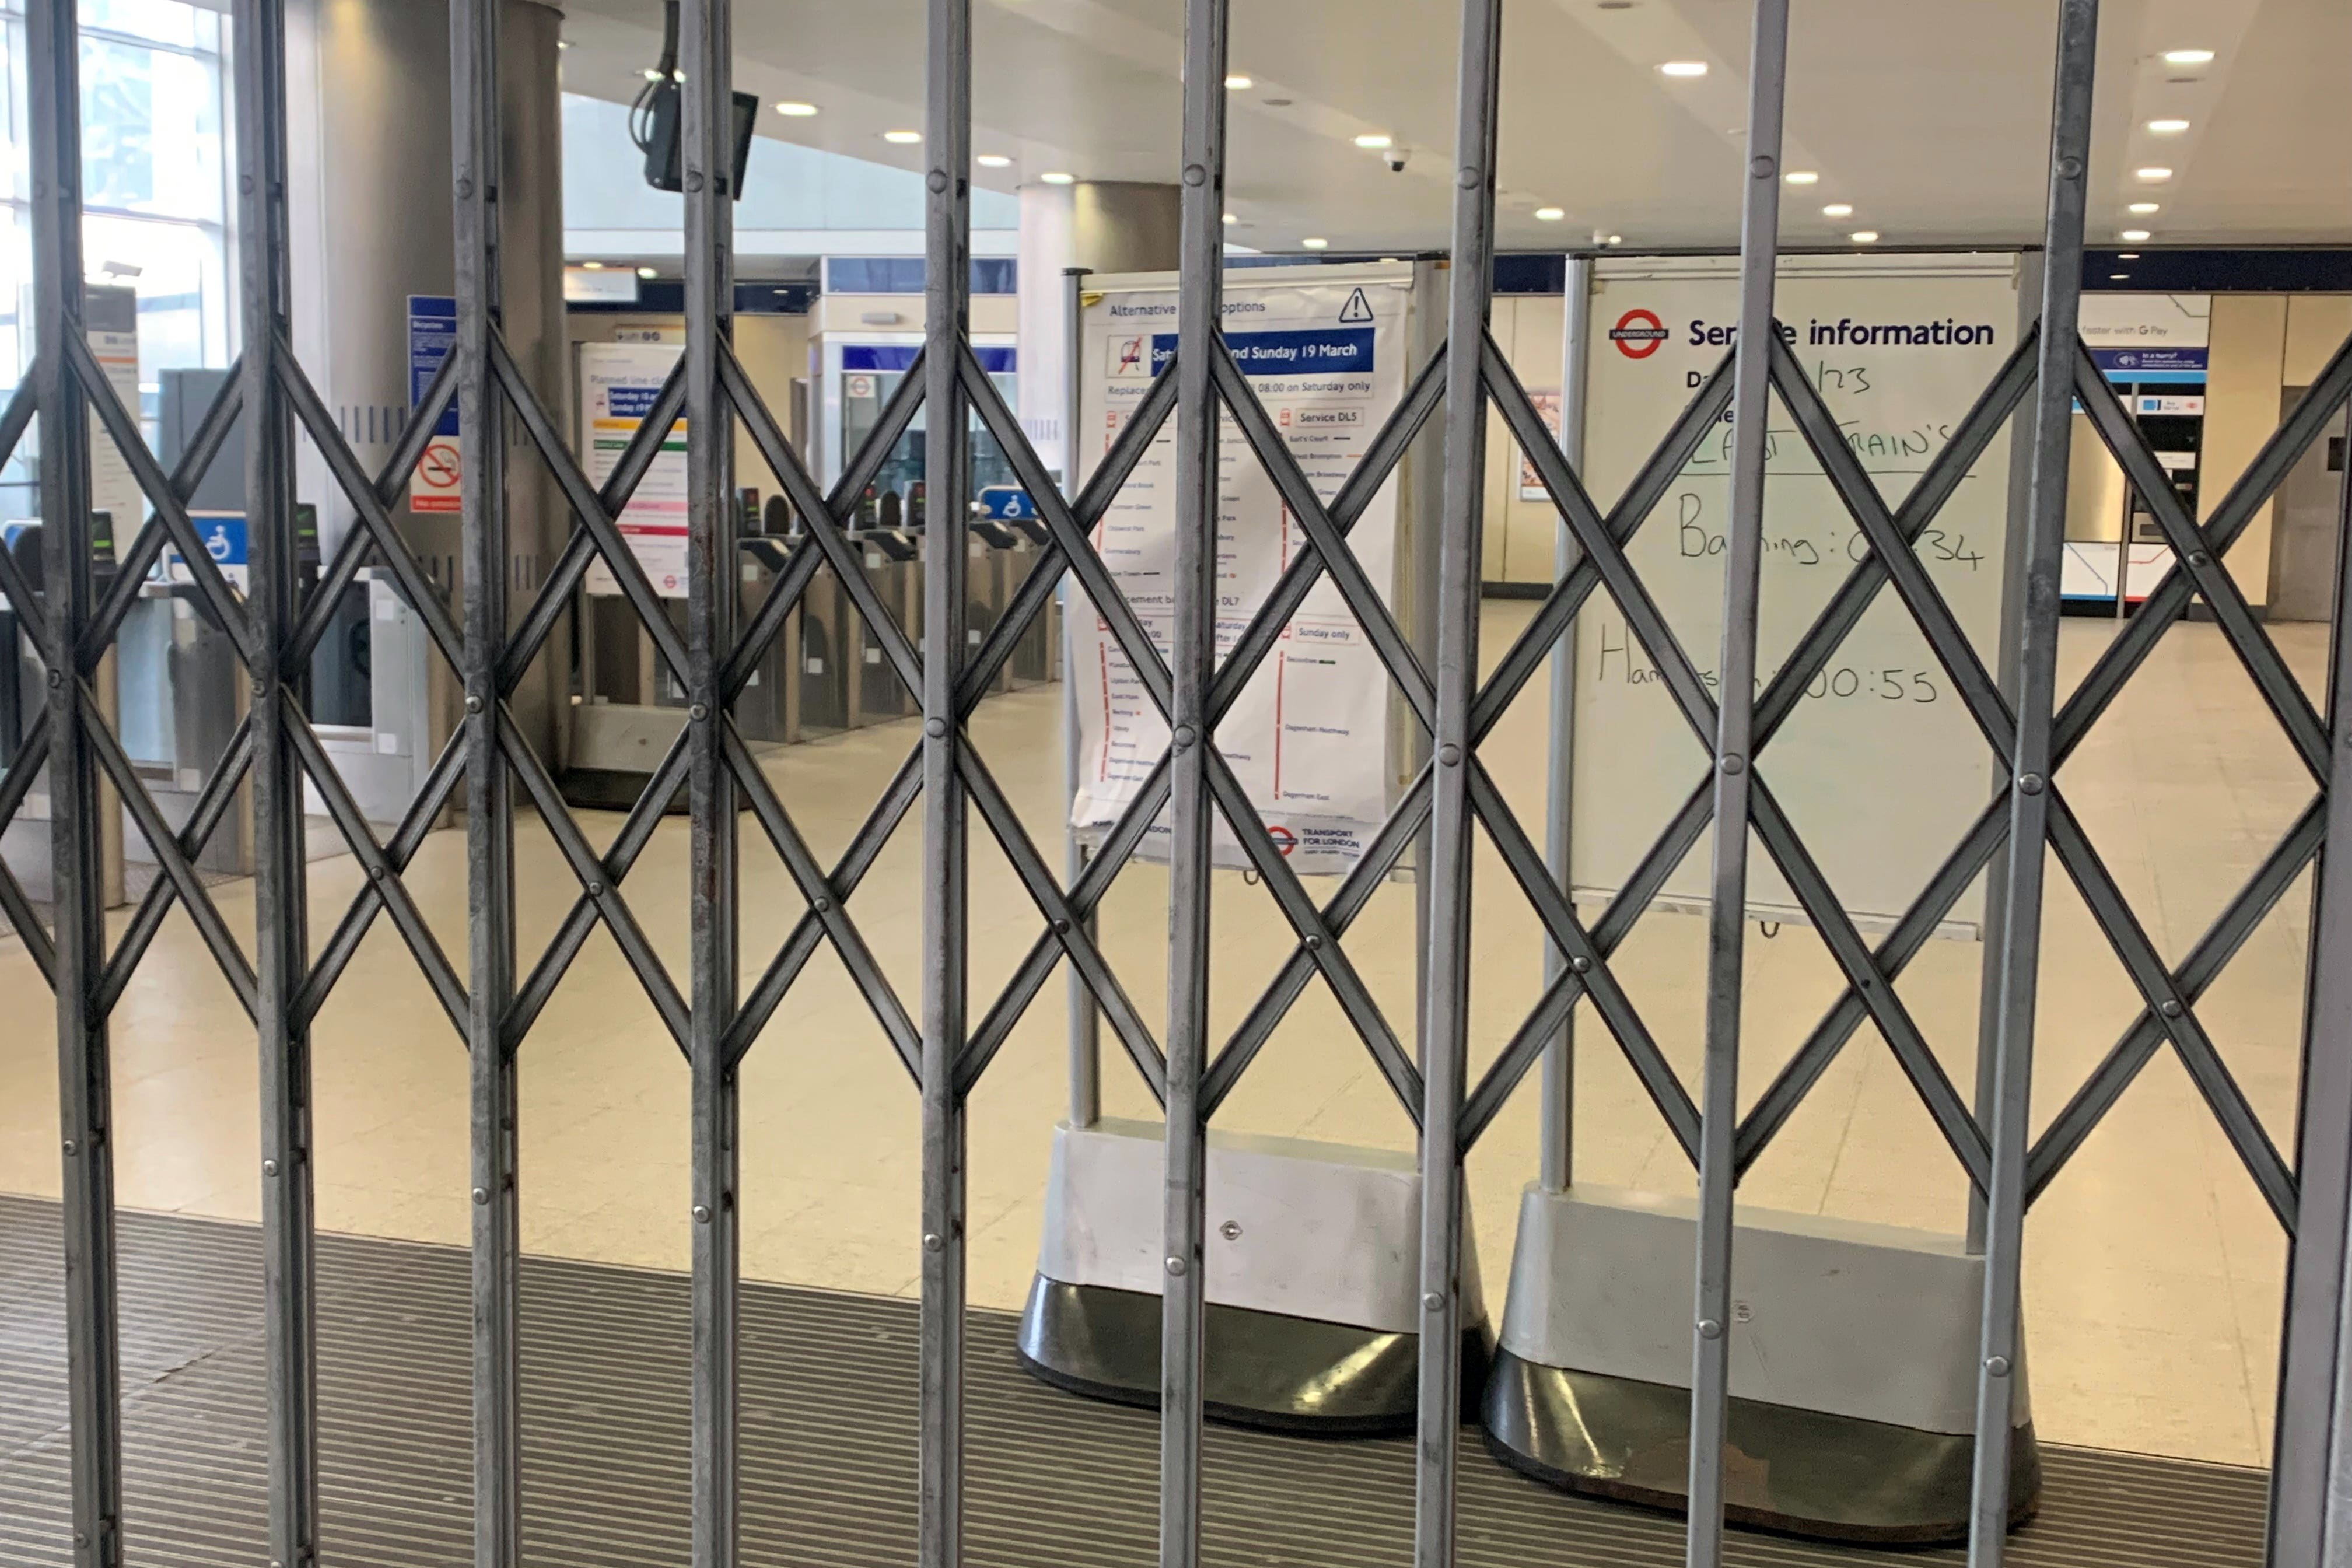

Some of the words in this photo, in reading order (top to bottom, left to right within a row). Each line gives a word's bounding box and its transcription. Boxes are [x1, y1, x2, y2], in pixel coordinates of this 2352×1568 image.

[1110, 303, 1177, 317] Alternative
[1221, 302, 1265, 316] options
[1688, 320, 1797, 346] Sere
[1809, 318, 1994, 346] information
[1231, 347, 1249, 359] nd
[1251, 346, 1297, 361] Sunday
[1301, 345, 1316, 358] 19
[1319, 343, 1357, 357] March
[1108, 386, 1147, 396] Replace
[1258, 383, 1284, 393] 08:00
[1287, 383, 1299, 391] on
[1301, 381, 1345, 394] Saturday
[1348, 380, 1371, 394] only
[1301, 413, 1335, 422] Service
[1338, 412, 1357, 421] DL5
[1222, 597, 1240, 605] DL7
[1298, 628, 1328, 639] Sunday
[1331, 631, 1350, 640] only
[1302, 828, 1353, 837] TRANSPORT
[1322, 839, 1359, 848] LONDON
